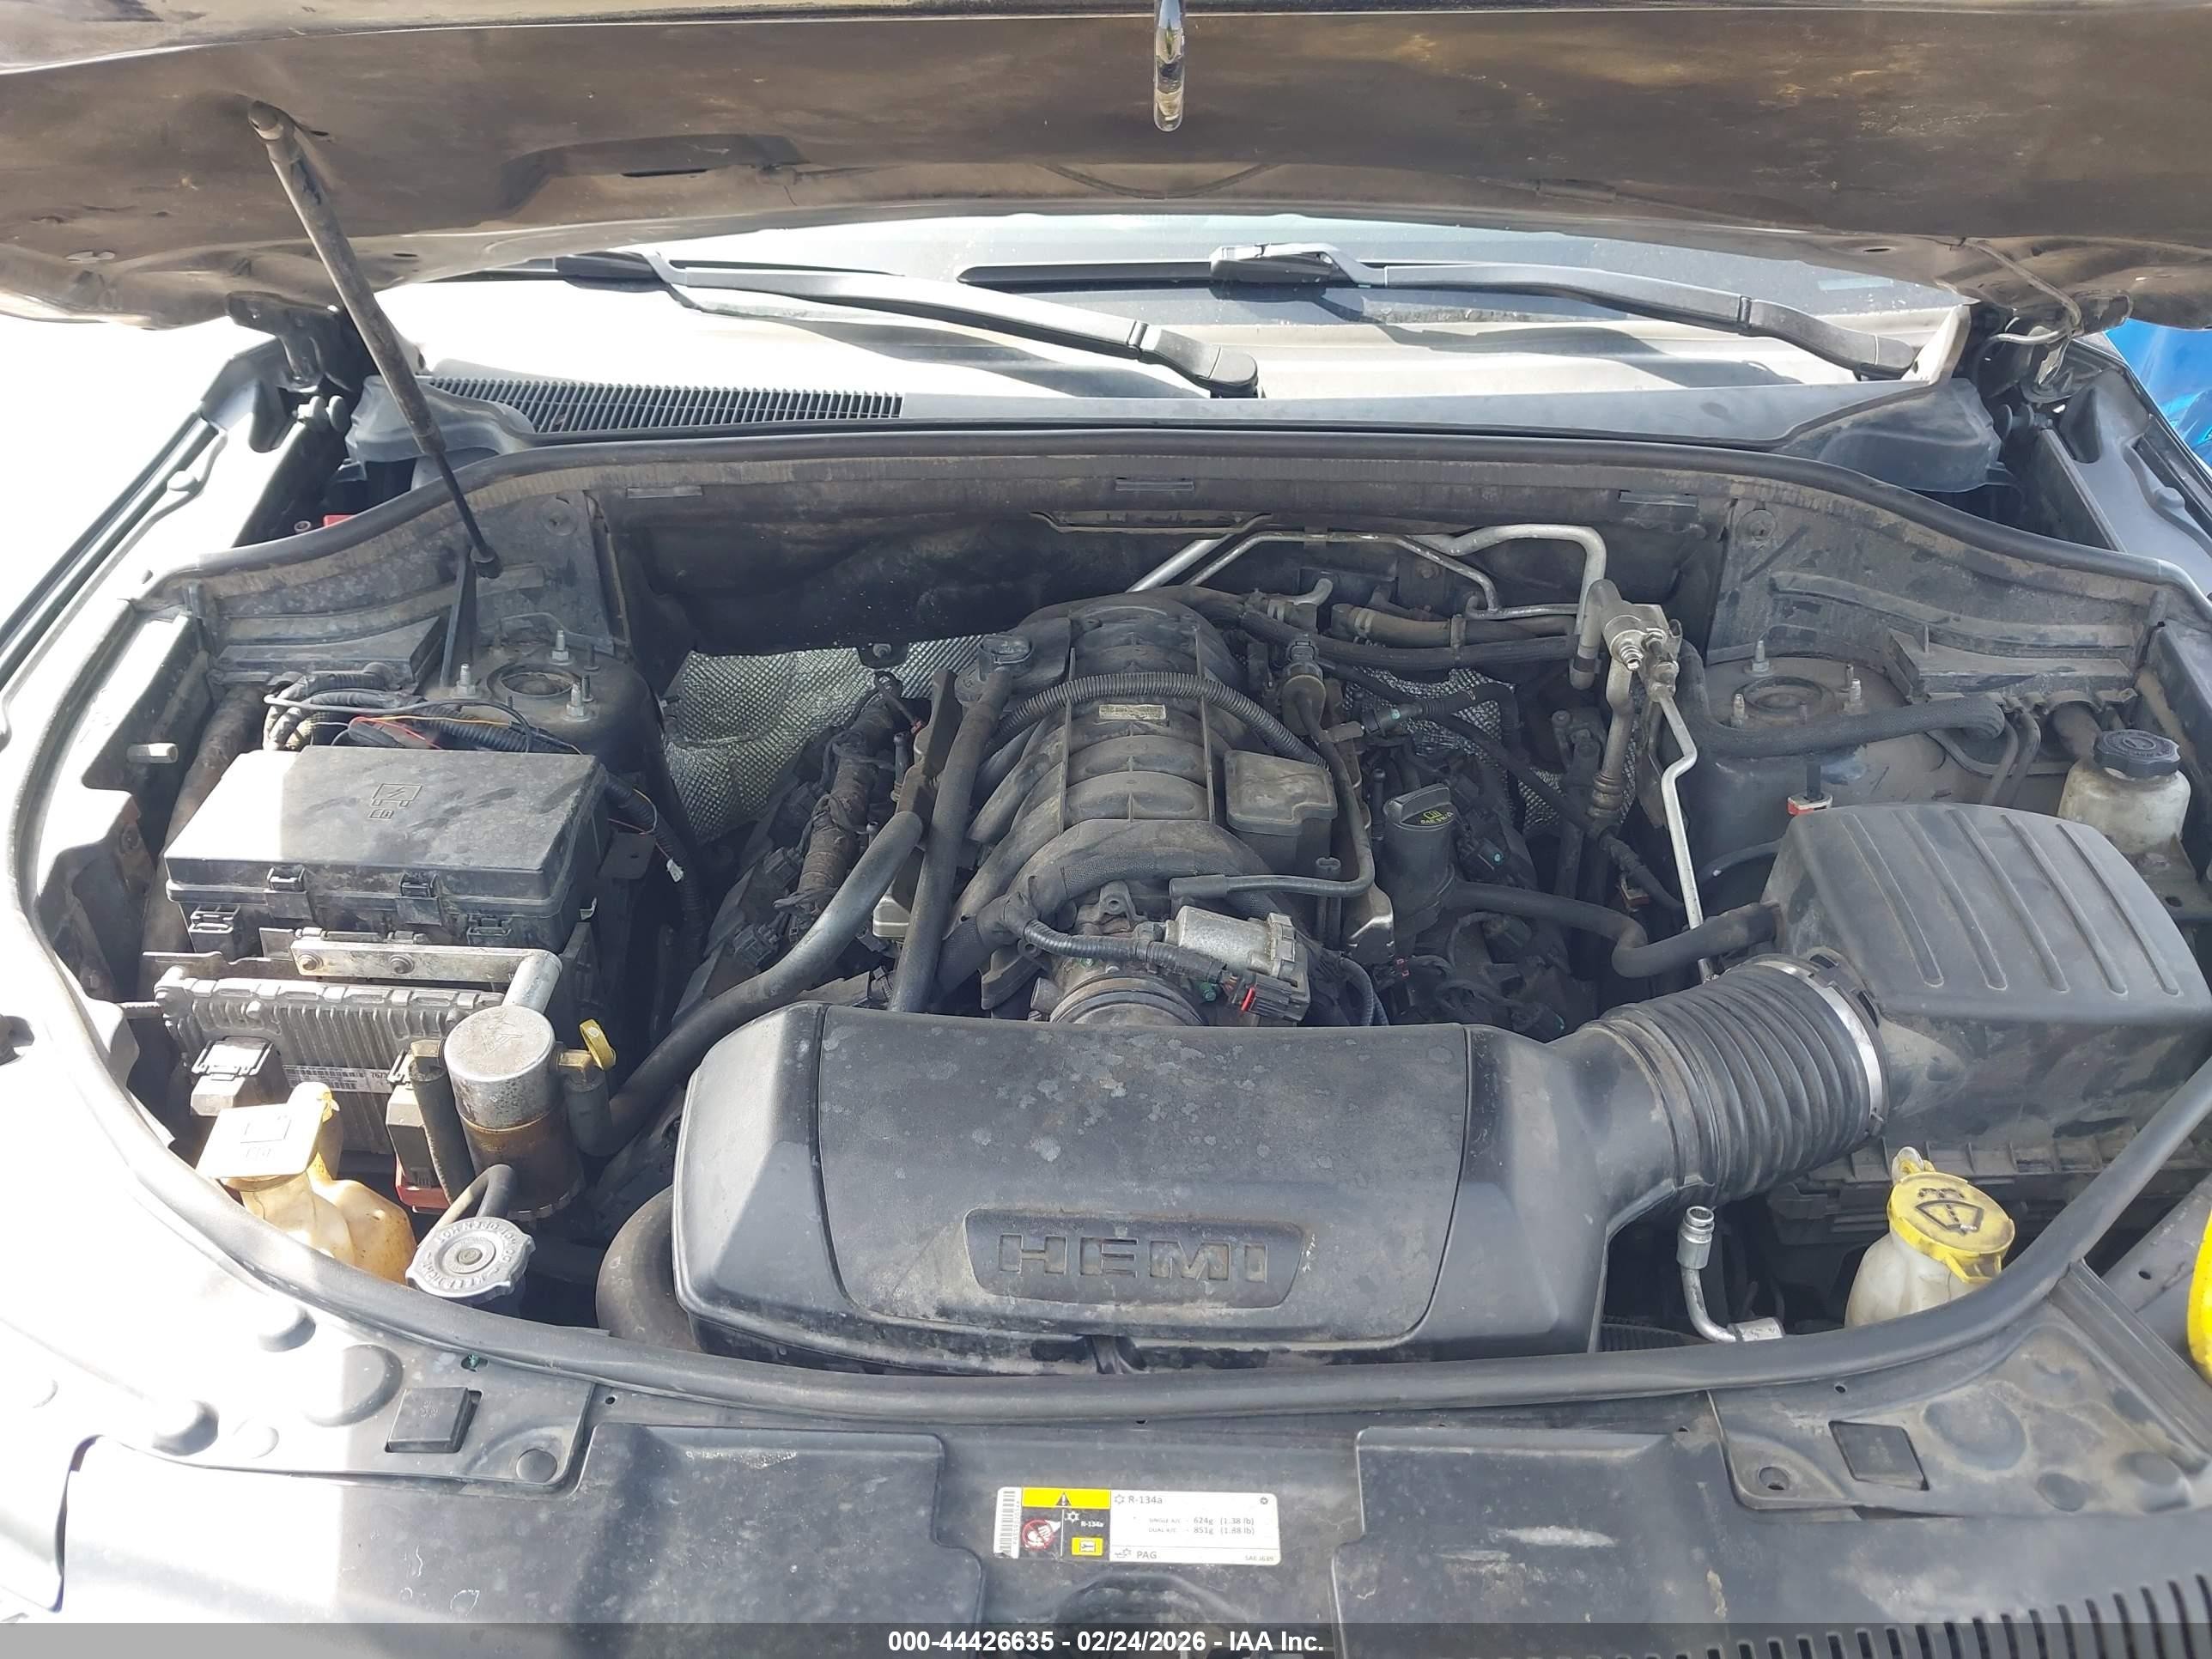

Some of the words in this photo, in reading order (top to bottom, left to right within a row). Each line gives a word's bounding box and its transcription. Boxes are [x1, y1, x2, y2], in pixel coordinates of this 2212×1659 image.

[999, 1234, 1268, 1285] HEMI
[1127, 1495, 1164, 1504] R-134a
[1193, 1516, 1214, 1525] 624g
[1136, 1551, 1158, 1559] PAG
